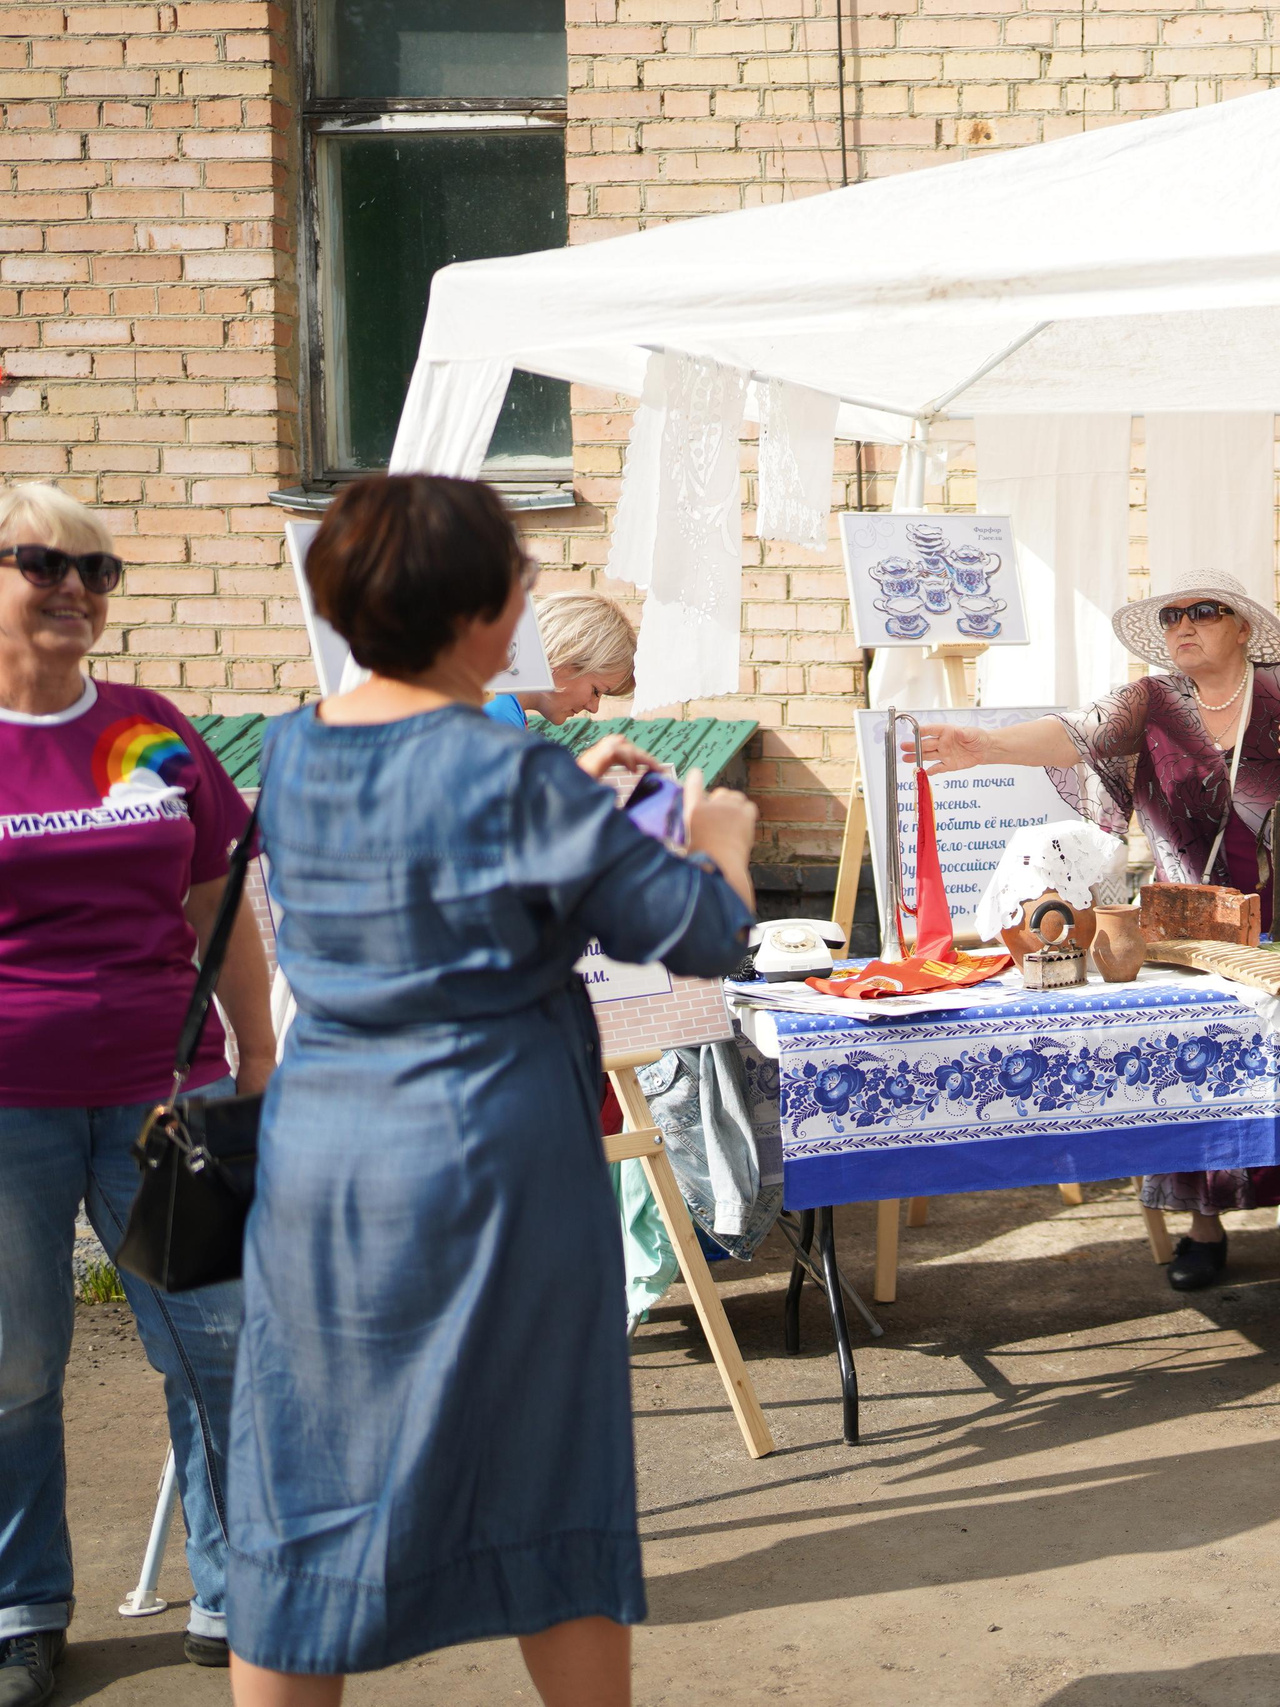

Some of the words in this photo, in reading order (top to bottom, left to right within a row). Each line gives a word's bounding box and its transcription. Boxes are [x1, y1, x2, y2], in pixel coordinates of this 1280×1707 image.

[943, 779, 969, 790] это
[972, 777, 1015, 788] точка
[984, 816, 997, 829] её
[940, 859, 999, 874] российск
